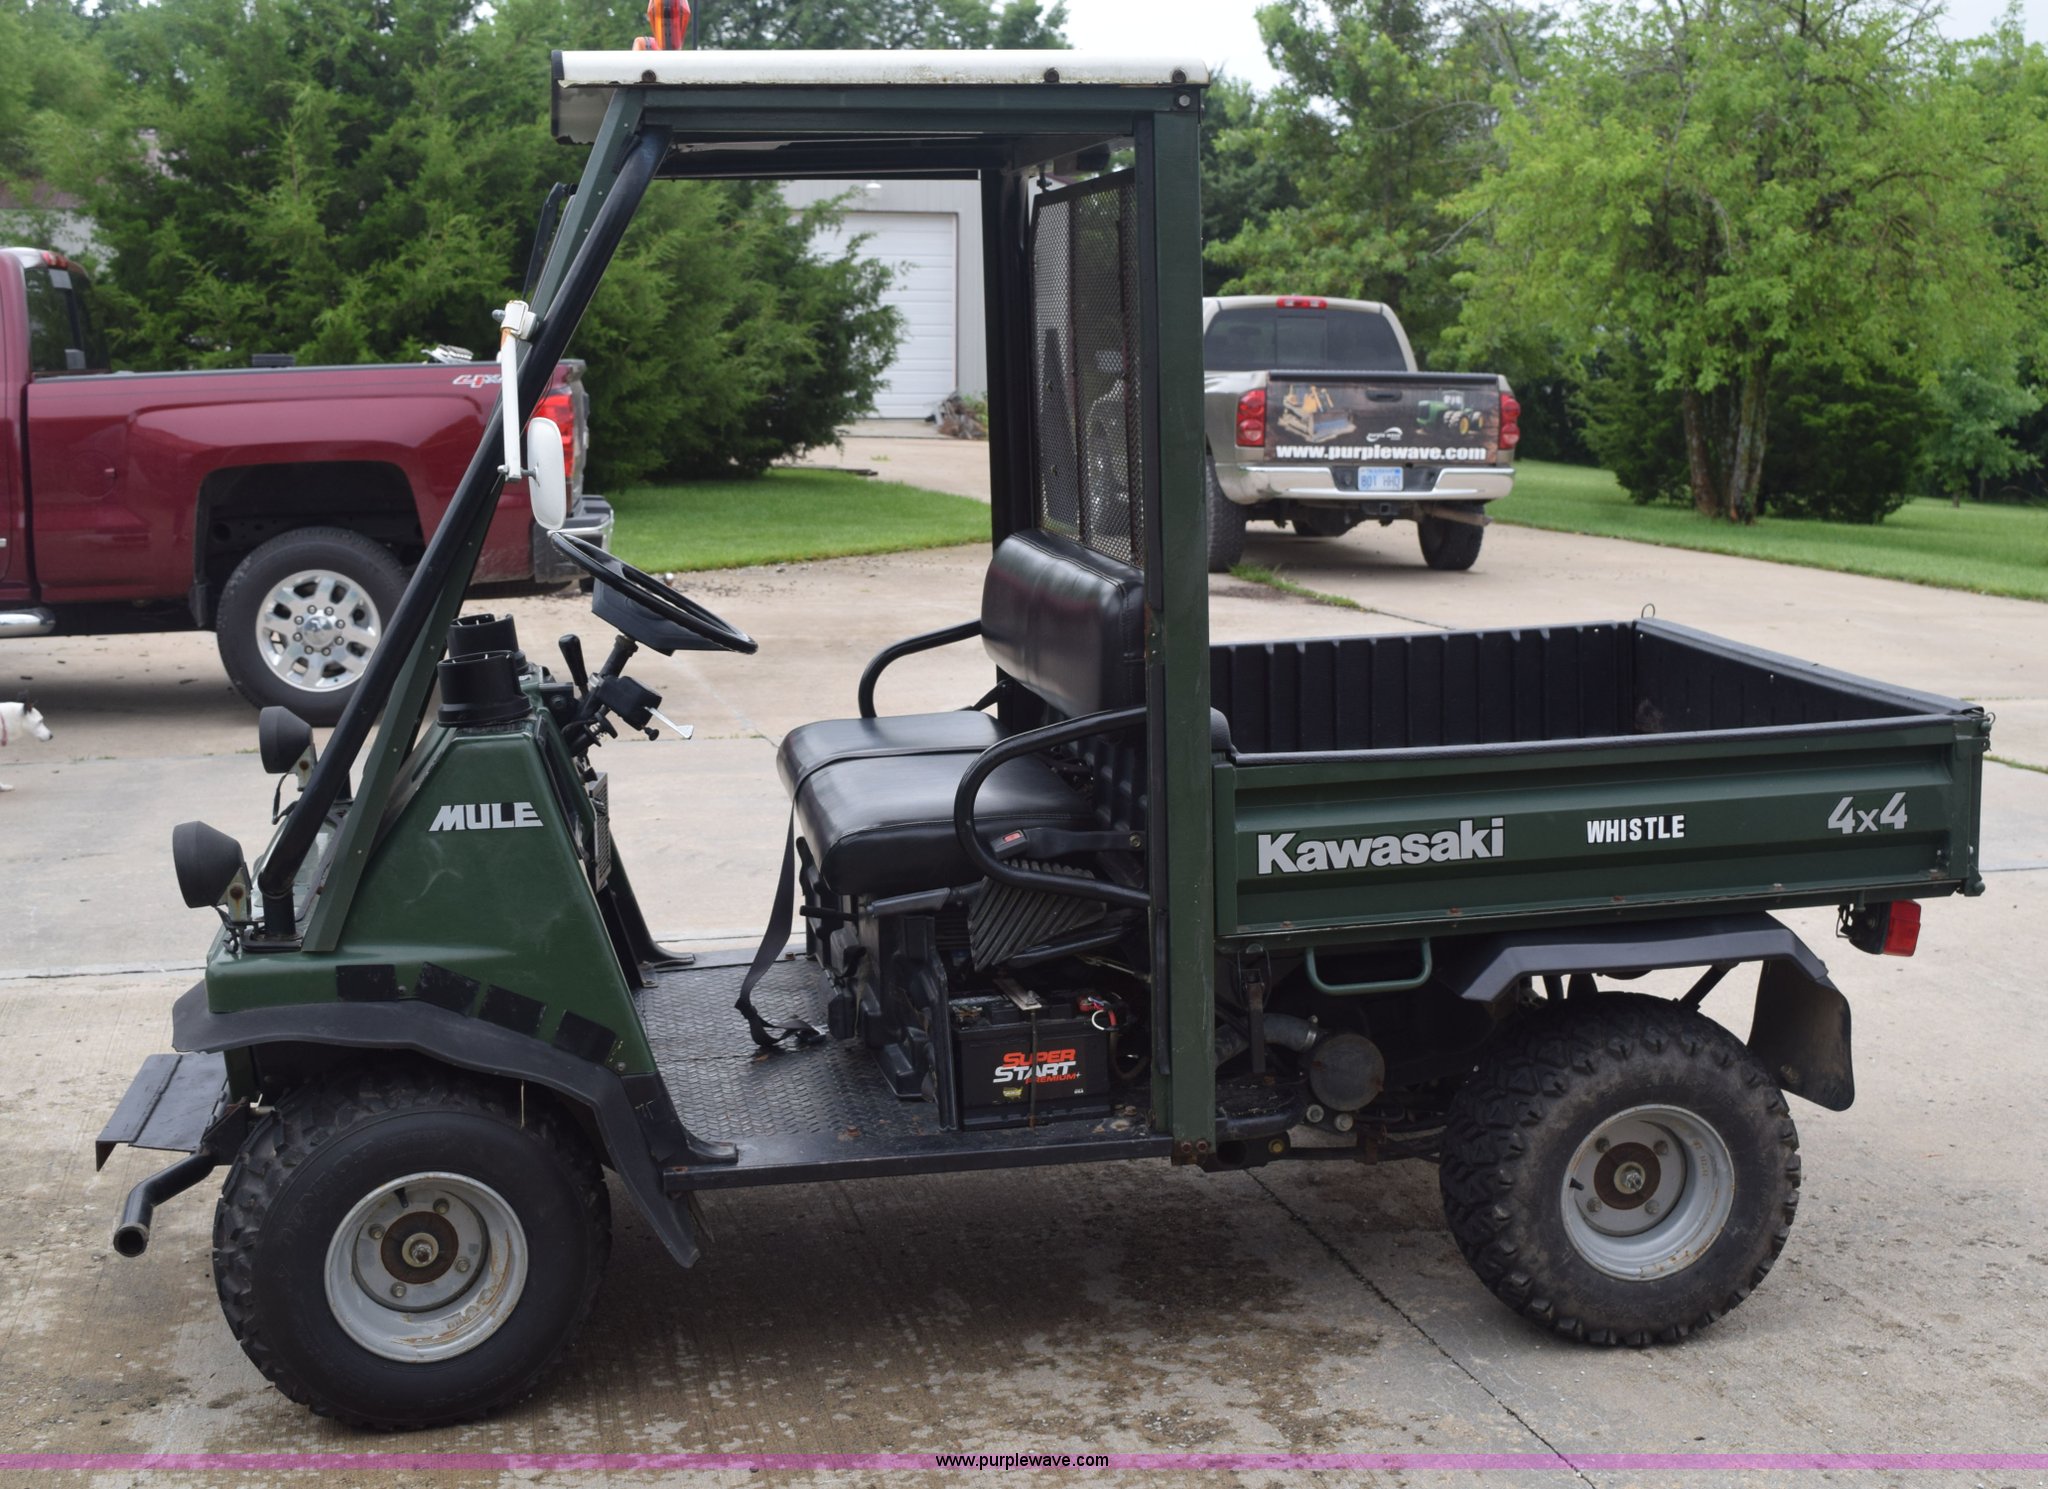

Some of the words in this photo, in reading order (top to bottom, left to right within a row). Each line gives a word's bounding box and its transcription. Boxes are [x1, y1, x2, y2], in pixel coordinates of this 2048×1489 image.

[453, 374, 503, 388] 4X
[1276, 444, 1486, 461] www.purplewave.com
[428, 802, 544, 832] MULE
[1827, 792, 1908, 835] 4x4
[1587, 815, 1686, 844] WHISTLE
[1257, 817, 1505, 876] Kawasaki
[1002, 1049, 1076, 1067] SUPER
[993, 1060, 1077, 1083] START
